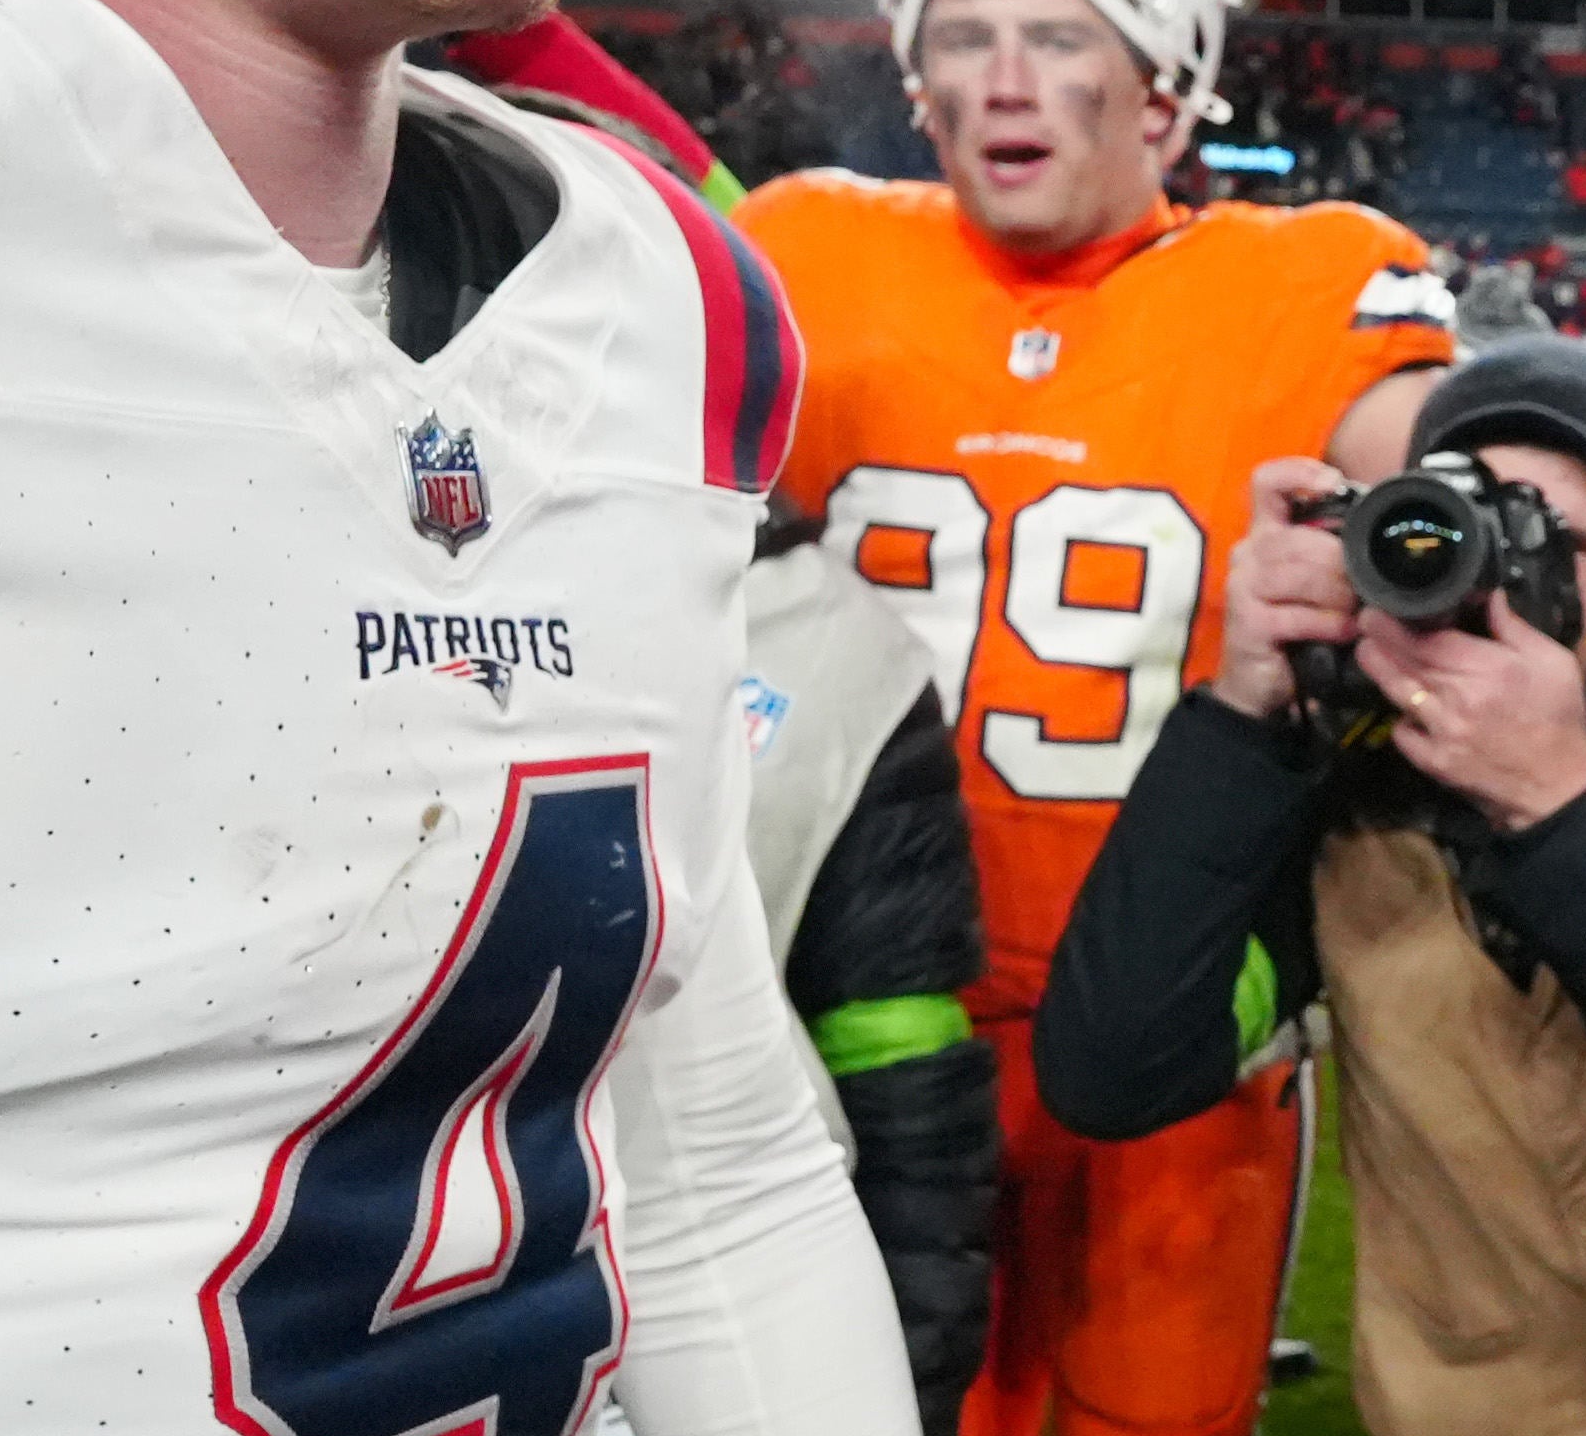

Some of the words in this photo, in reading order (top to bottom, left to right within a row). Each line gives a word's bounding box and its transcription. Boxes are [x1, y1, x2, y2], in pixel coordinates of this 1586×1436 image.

[421, 474, 480, 528] NFL
[355, 611, 574, 680] PATRIOTS
[826, 463, 1206, 802] 99
